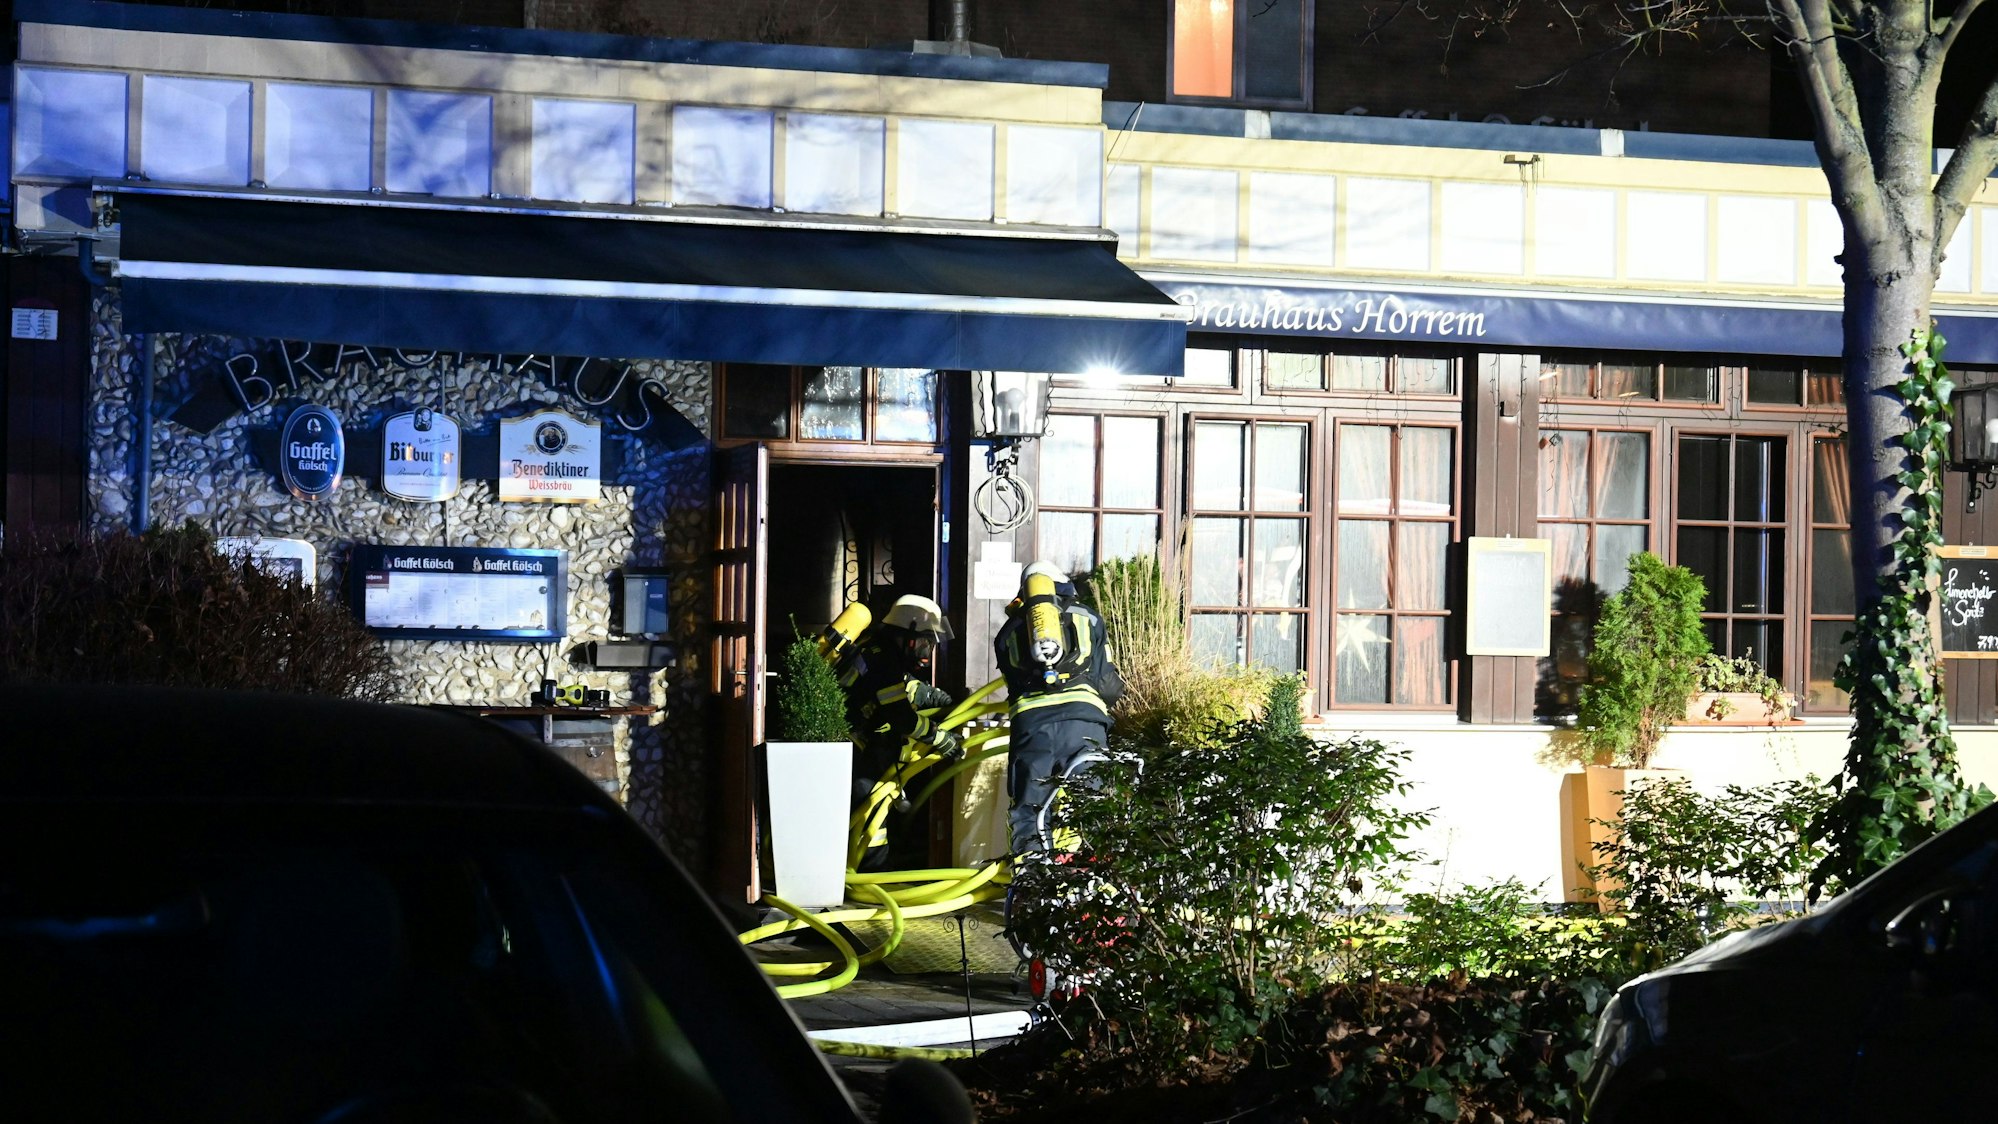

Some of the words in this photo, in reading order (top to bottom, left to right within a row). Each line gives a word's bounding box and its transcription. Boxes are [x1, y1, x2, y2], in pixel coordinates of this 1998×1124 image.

[1173, 290, 1343, 332] Brauhaus
[1352, 298, 1487, 336] Horrem
[289, 441, 337, 460] Gaffel
[298, 460, 328, 472] Kölsch
[511, 459, 589, 478] Benediktiner
[528, 479, 572, 491] Weissbräu
[393, 557, 421, 569] Gaffel
[422, 558, 454, 571] Kölsch
[483, 559, 511, 571] Gaffel
[512, 560, 543, 573] Kölsch
